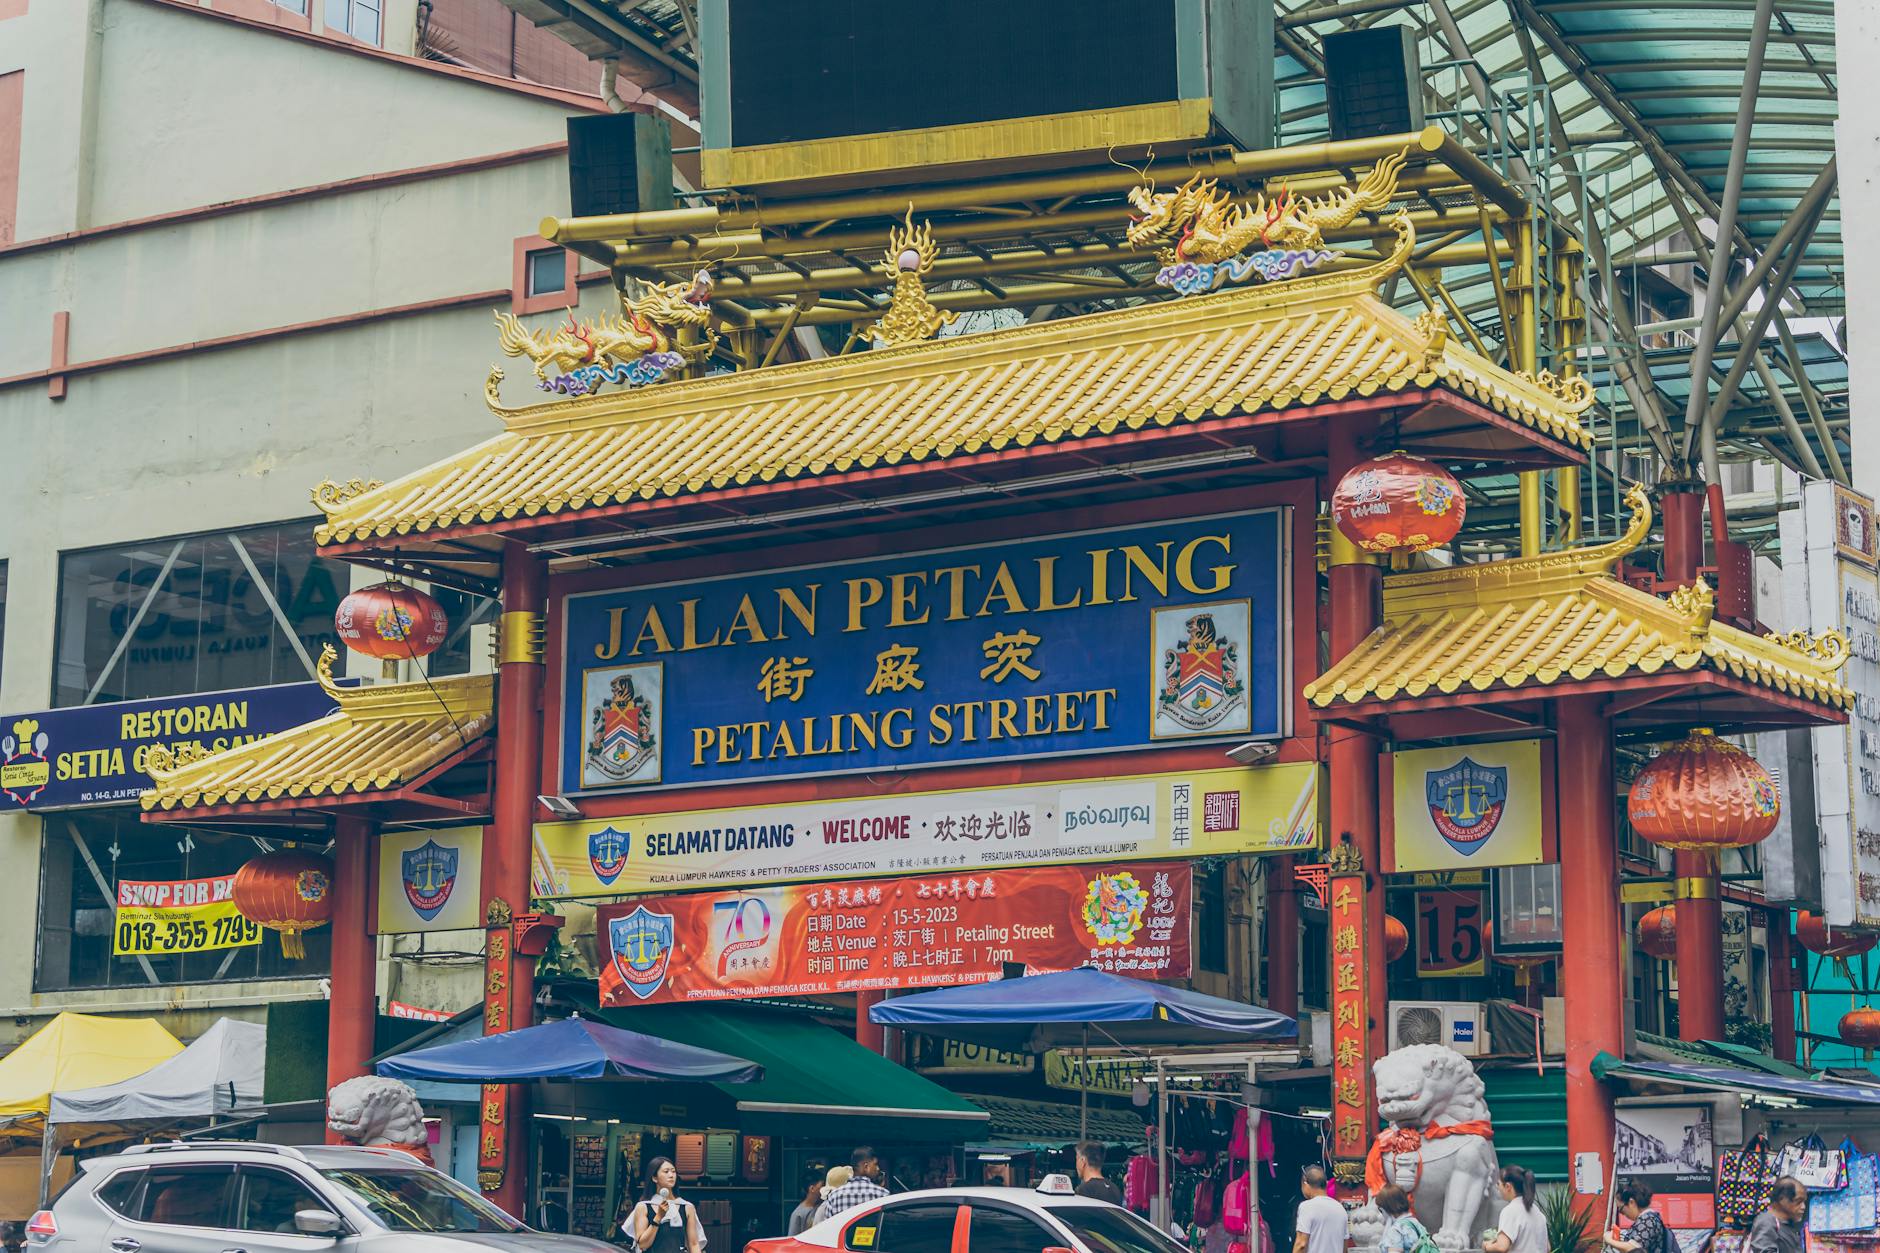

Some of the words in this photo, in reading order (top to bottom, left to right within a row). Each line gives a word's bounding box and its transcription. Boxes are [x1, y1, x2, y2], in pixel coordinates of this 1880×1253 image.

[594, 584, 822, 660] JALAN
[841, 533, 1238, 633] PETALING
[121, 701, 248, 740] RESTORAN
[690, 707, 914, 766] PETALING
[928, 688, 1117, 746] STREET
[56, 748, 126, 781] SETIA
[81, 793, 93, 801] NO.
[113, 790, 126, 799] JLN
[933, 810, 1032, 842] 欢迎光临
[1064, 805, 1150, 833] நல்வரவு
[1172, 784, 1190, 846] 丙申年
[646, 829, 722, 857] SELAMAT
[725, 824, 795, 851] DATANG
[822, 815, 911, 844] WELCOME
[981, 850, 1013, 862] PERSATUAN
[1014, 849, 1038, 860] PENJAJA
[1039, 848, 1051, 858] DAN
[1052, 846, 1076, 857] PENIAGA
[1077, 845, 1093, 855] KECIL
[1094, 844, 1113, 855] KUALA
[1114, 842, 1137, 853] LUMPUR
[650, 873, 675, 883] KUALA
[676, 871, 707, 882] LUMPUR
[749, 868, 756, 877] &
[757, 866, 782, 876] PETTY
[823, 860, 876, 872] ASSOCIATION
[120, 882, 170, 906] SHOP
[173, 882, 209, 906] FOR
[119, 921, 208, 952] 013-355
[213, 914, 258, 946] 1799
[713, 898, 771, 943] 70
[807, 915, 833, 932] 日期
[836, 914, 866, 930] Date
[893, 906, 958, 925] 15-5-2023
[807, 935, 834, 953] 地点
[836, 934, 877, 950] Venue
[892, 928, 935, 947] 茨厂街
[956, 925, 1009, 945] Petaling
[1013, 924, 1054, 940] Street
[1420, 905, 1481, 963] 15
[722, 939, 762, 959] ANNIVERSARY
[807, 957, 834, 974] 时间
[838, 956, 869, 971] Time
[893, 948, 964, 968] 晚上七时正
[985, 947, 1013, 966] 7pm
[687, 987, 727, 998] PERSATUAN
[727, 986, 754, 997] PENJAJA
[754, 986, 768, 995] DAN
[769, 984, 798, 995] PENIAGA
[799, 982, 817, 993] KECIL
[908, 975, 920, 985] K.L.
[958, 973, 963, 982] &
[964, 971, 986, 983] PETTY
[1454, 1028, 1473, 1036] Haier
[1689, 1175, 1711, 1183] Petaling
